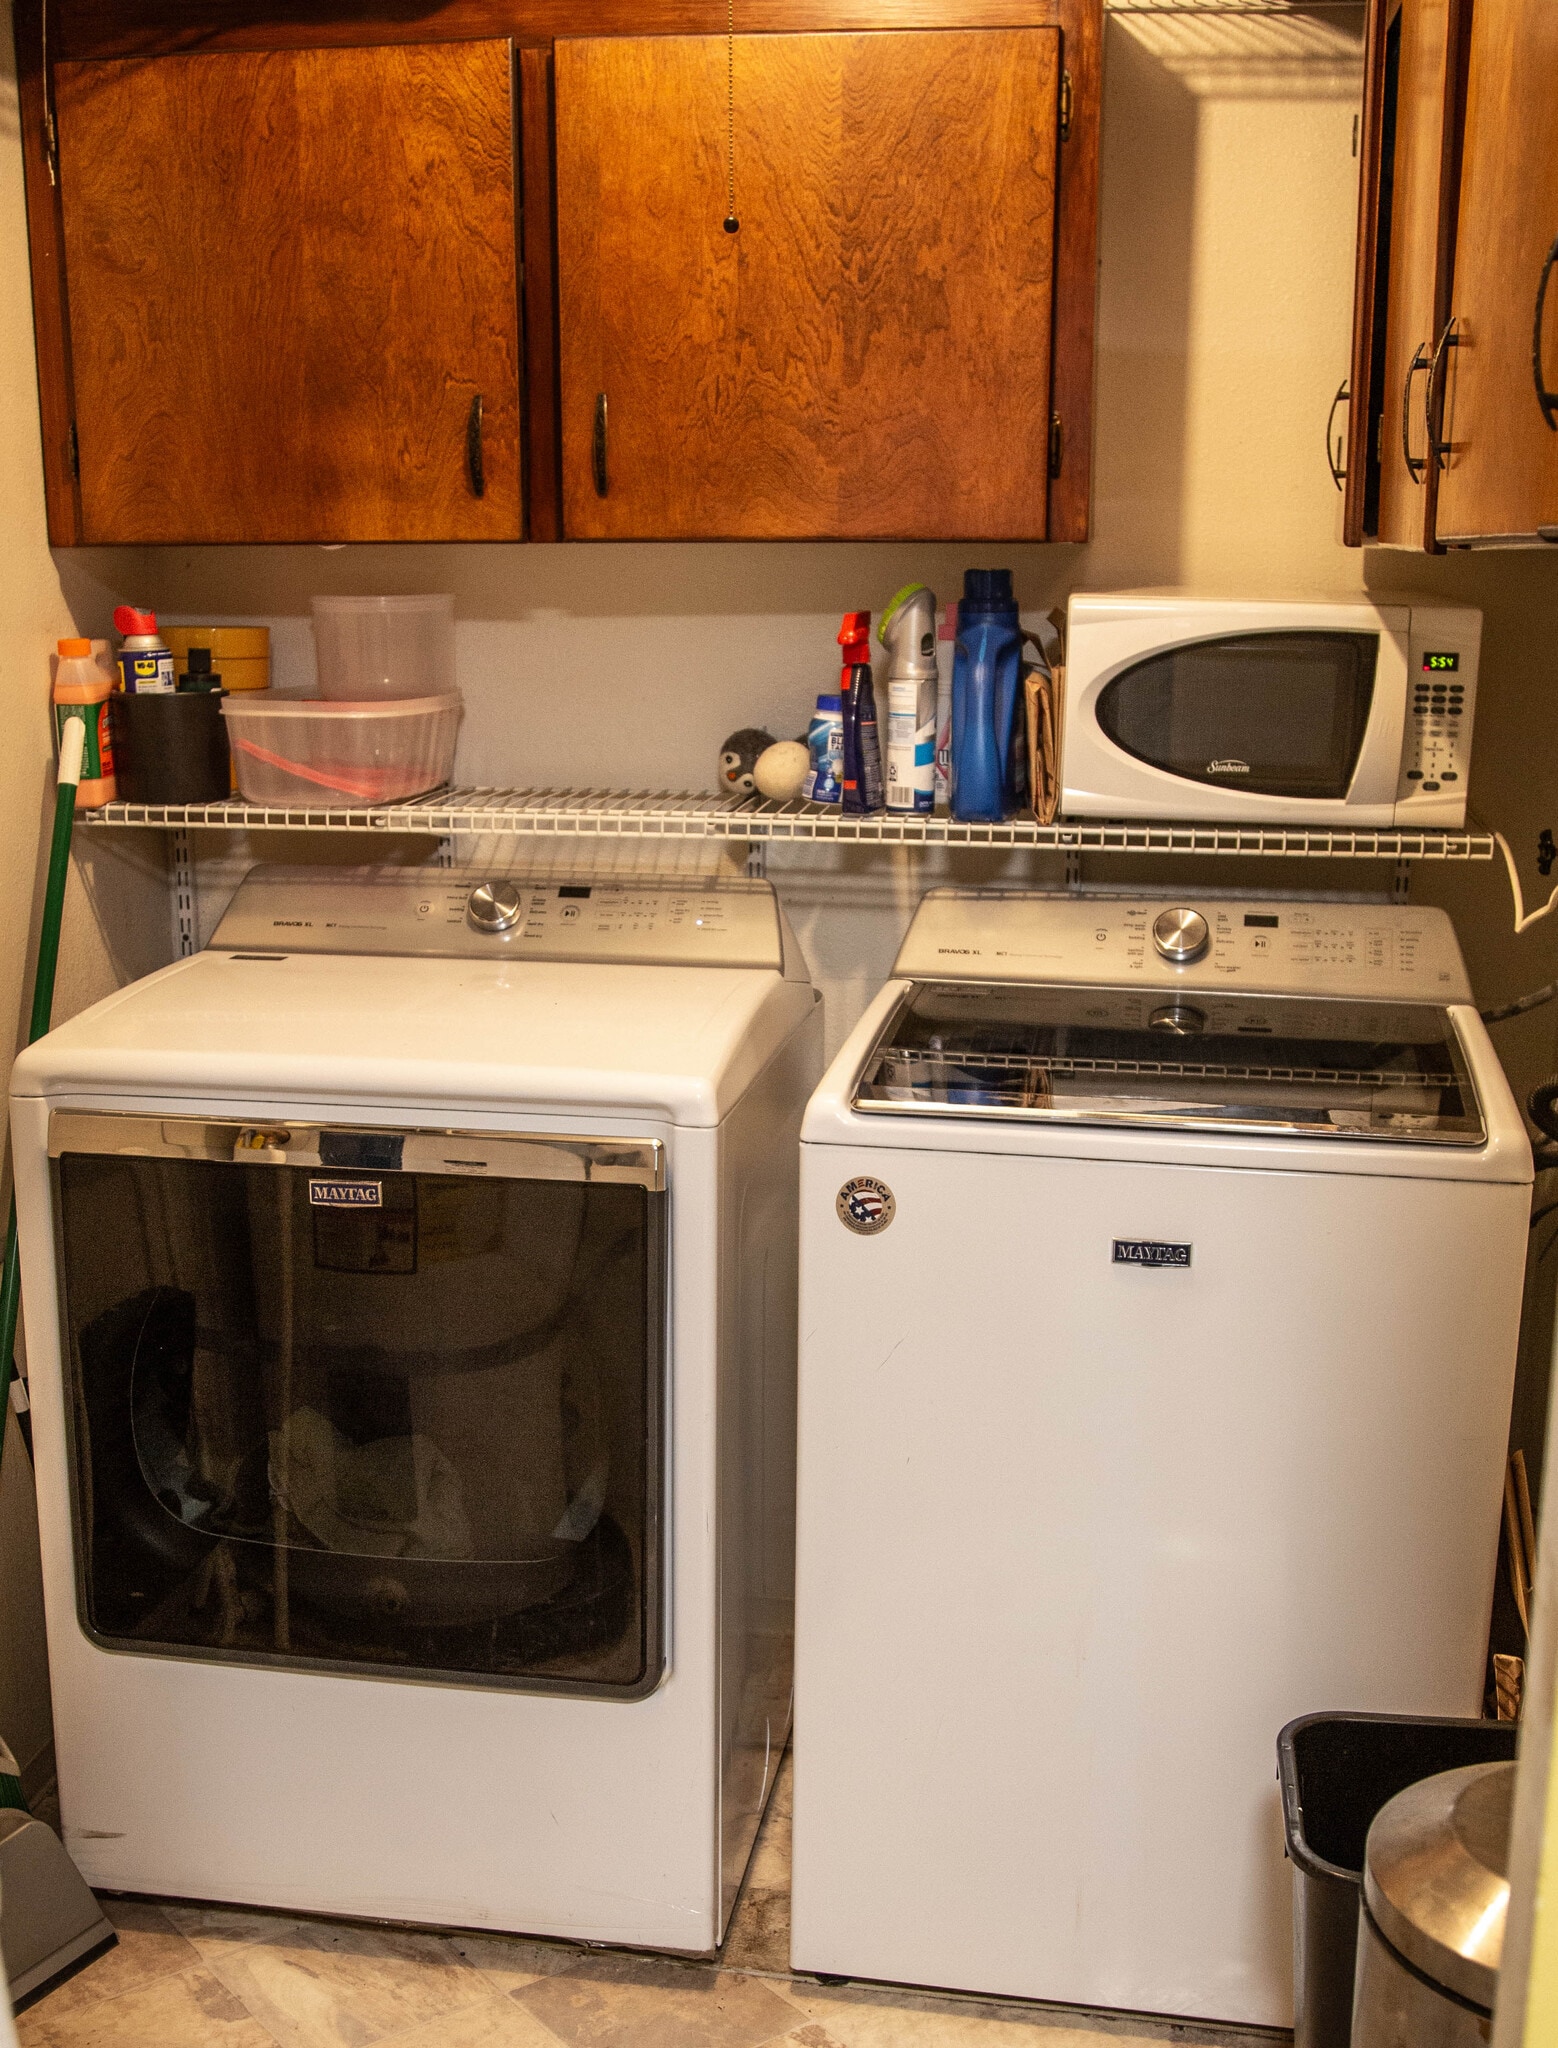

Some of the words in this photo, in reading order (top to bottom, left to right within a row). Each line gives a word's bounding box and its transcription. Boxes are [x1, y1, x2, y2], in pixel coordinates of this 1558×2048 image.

[1430, 656, 1453, 668] 5:54
[1207, 759, 1250, 773] Sunbeam
[313, 1186, 378, 1202] MAYTAG
[840, 1178, 892, 1202] AMERICA
[1117, 1244, 1188, 1263] MAYTAG
